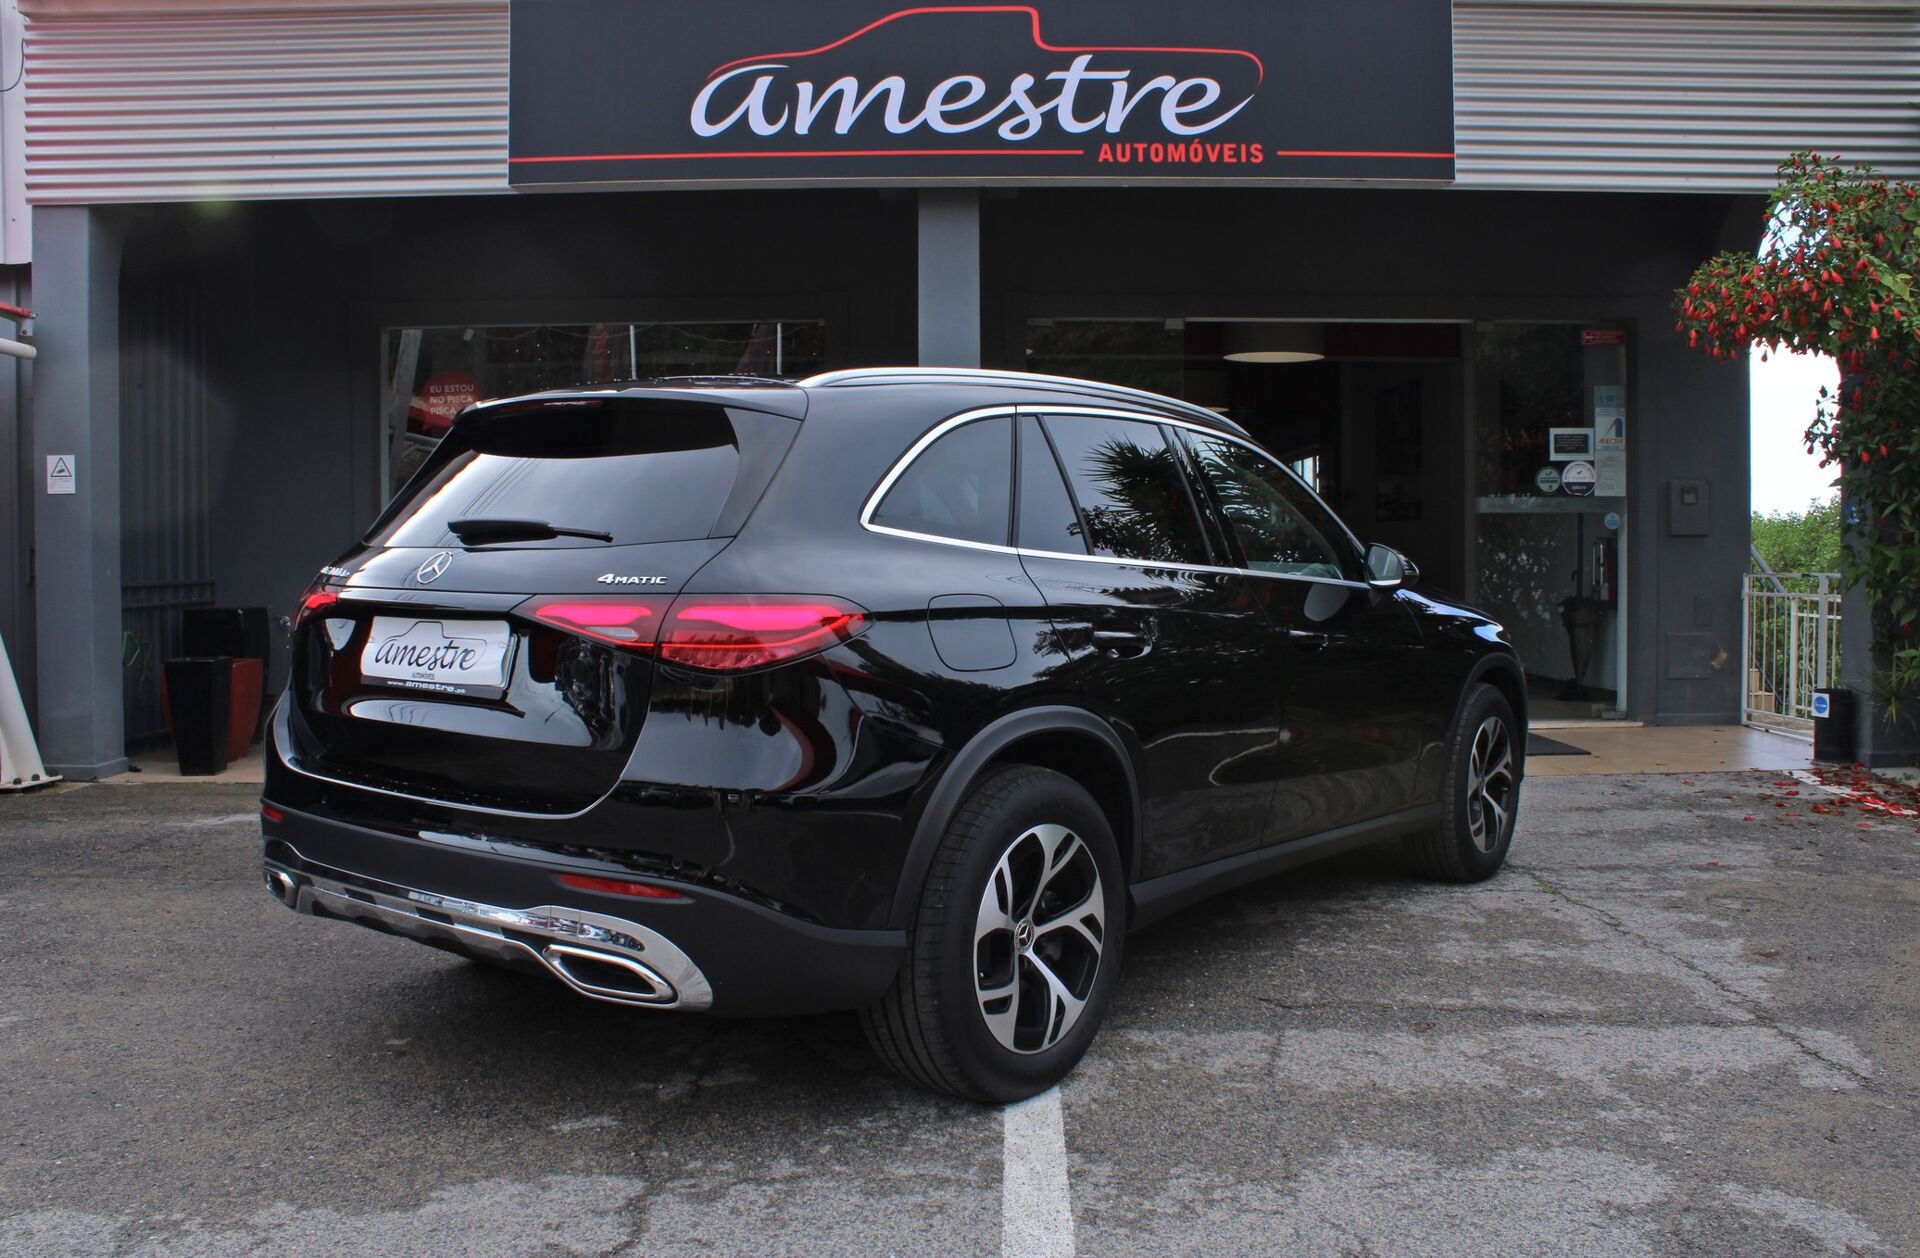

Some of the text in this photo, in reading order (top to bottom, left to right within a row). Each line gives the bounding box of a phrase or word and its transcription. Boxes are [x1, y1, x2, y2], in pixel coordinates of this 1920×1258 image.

[691, 54, 1257, 141] amestre
[1098, 140, 1265, 164] AUTOMÓVEIS
[445, 384, 474, 393] ESTOU
[430, 395, 473, 404] NO PISCA
[430, 407, 457, 415] PISCA
[596, 573, 668, 585] 4MATIC
[375, 639, 482, 671] amestre
[387, 680, 466, 693] www.amestre.pt
